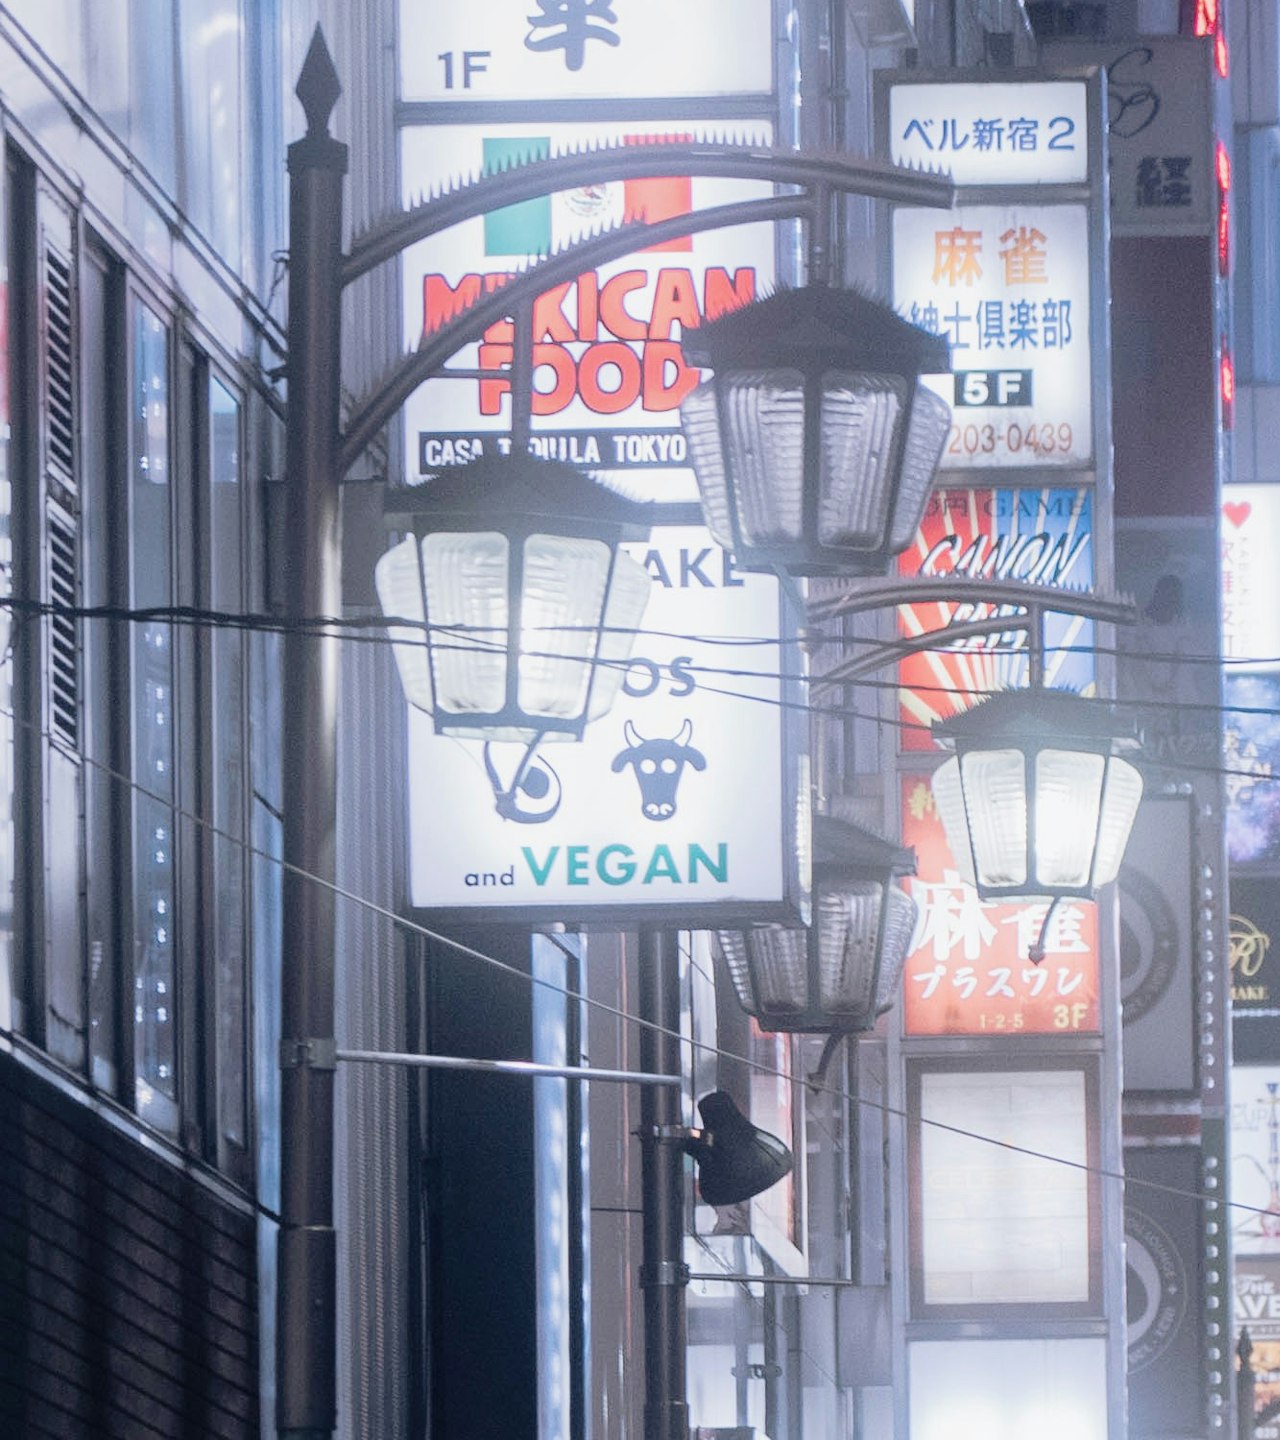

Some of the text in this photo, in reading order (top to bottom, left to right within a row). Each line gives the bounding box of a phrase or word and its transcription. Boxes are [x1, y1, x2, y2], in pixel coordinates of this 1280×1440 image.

[437, 50, 491, 91] 1F
[903, 116, 1076, 152] ベル新宿2
[931, 226, 1050, 287] 麻雀
[963, 372, 1022, 405] 5F
[613, 433, 687, 462] TOKYO
[984, 496, 1088, 518] GAME
[465, 842, 729, 888] and VEGAN
[912, 870, 1091, 961] 麻雀
[912, 965, 1084, 1001] プラスワン
[1053, 1004, 1088, 1029] 3F
